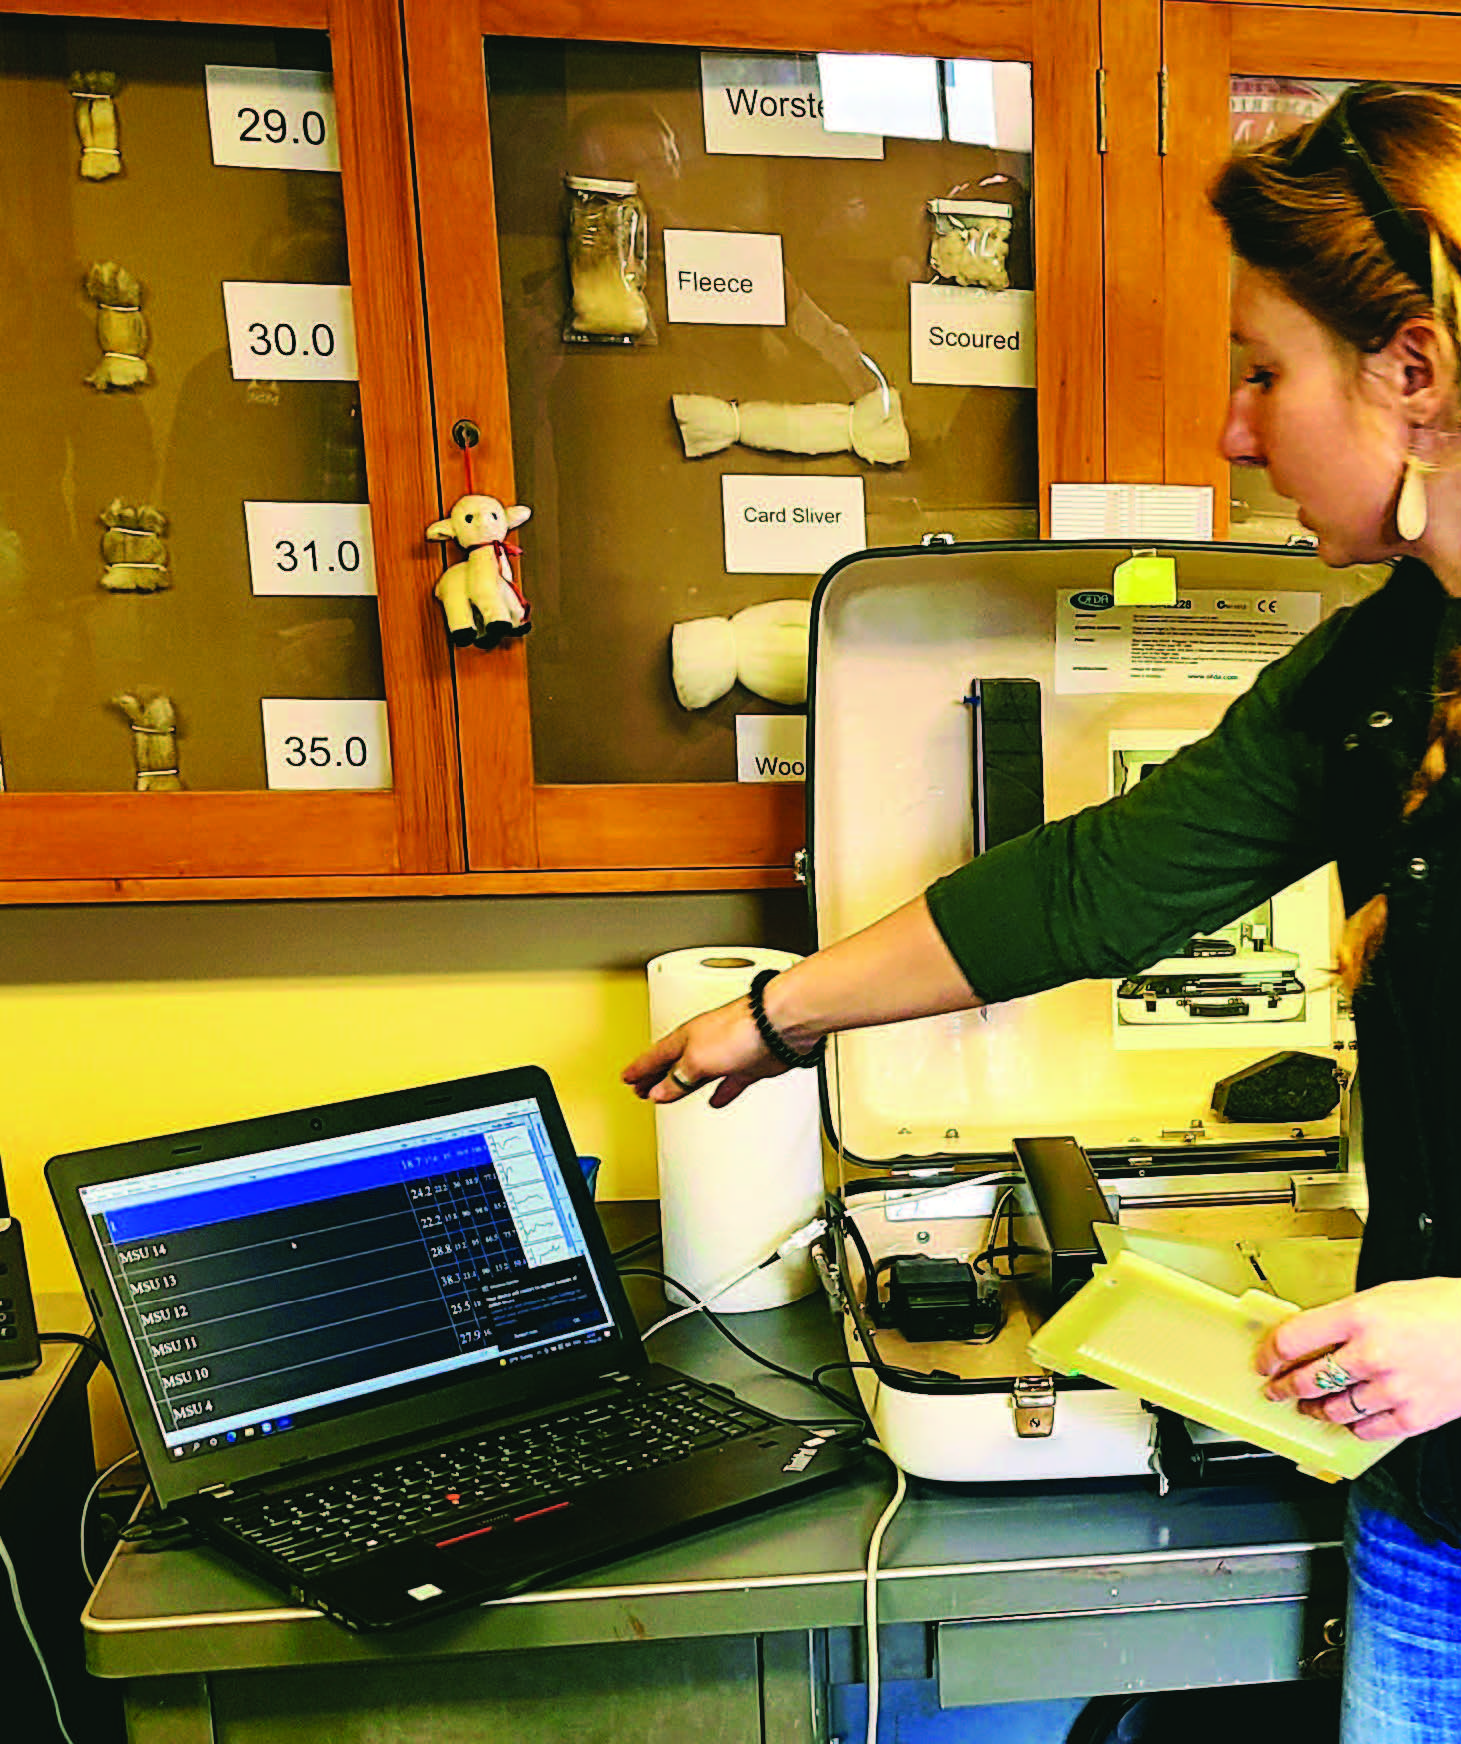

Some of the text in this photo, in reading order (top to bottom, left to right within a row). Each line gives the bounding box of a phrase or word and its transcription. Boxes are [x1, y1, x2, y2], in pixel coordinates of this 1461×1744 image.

[238, 107, 326, 145] 29.0
[677, 270, 753, 295] Fleece
[248, 322, 336, 358] 30.0
[928, 326, 1021, 352] Scoured
[743, 506, 842, 524] Card Sliver
[275, 540, 361, 574] 31.0
[283, 735, 368, 768] 35.0
[755, 756, 805, 777] Woo
[410, 1185, 433, 1200] 24.2
[420, 1214, 443, 1230] 22.2
[119, 1243, 167, 1264] MSU 14
[430, 1243, 453, 1259] 28.8
[129, 1274, 177, 1296] MSU 13
[140, 1304, 189, 1326] MSU 12
[450, 1300, 471, 1315] 25.5
[151, 1336, 198, 1358] MSU 11
[459, 1329, 481, 1345] 27.9
[161, 1367, 209, 1389] MSU 10
[173, 1399, 214, 1420] MSU 4
